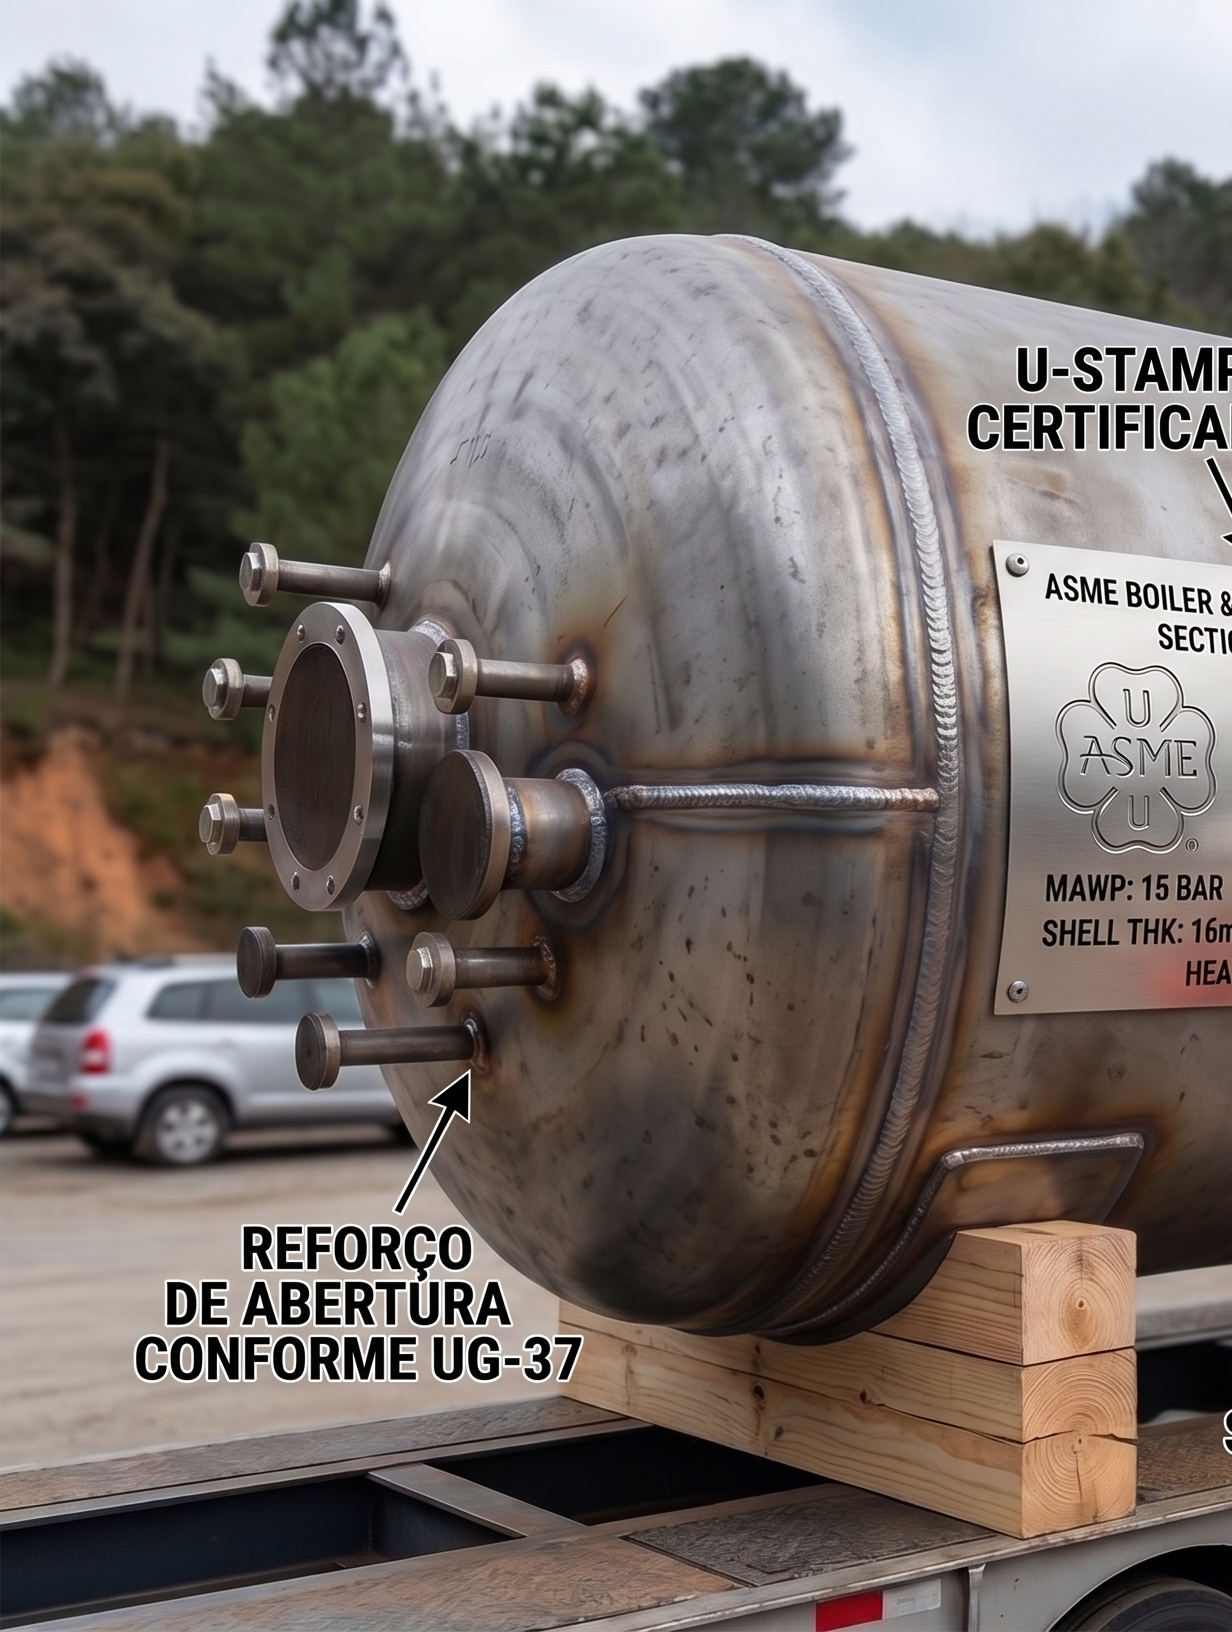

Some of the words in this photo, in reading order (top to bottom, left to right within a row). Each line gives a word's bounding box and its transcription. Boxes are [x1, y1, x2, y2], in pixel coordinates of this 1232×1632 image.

[1045, 573, 1119, 606] ASME
[1125, 580, 1214, 615] BOILER
[1080, 735, 1198, 778] ASME
[1045, 873, 1134, 903] MAWP:
[1141, 873, 1169, 901] 15
[1176, 874, 1224, 901] BAR
[1041, 918, 1120, 948] SHELL
[1126, 917, 1184, 945] THK:
